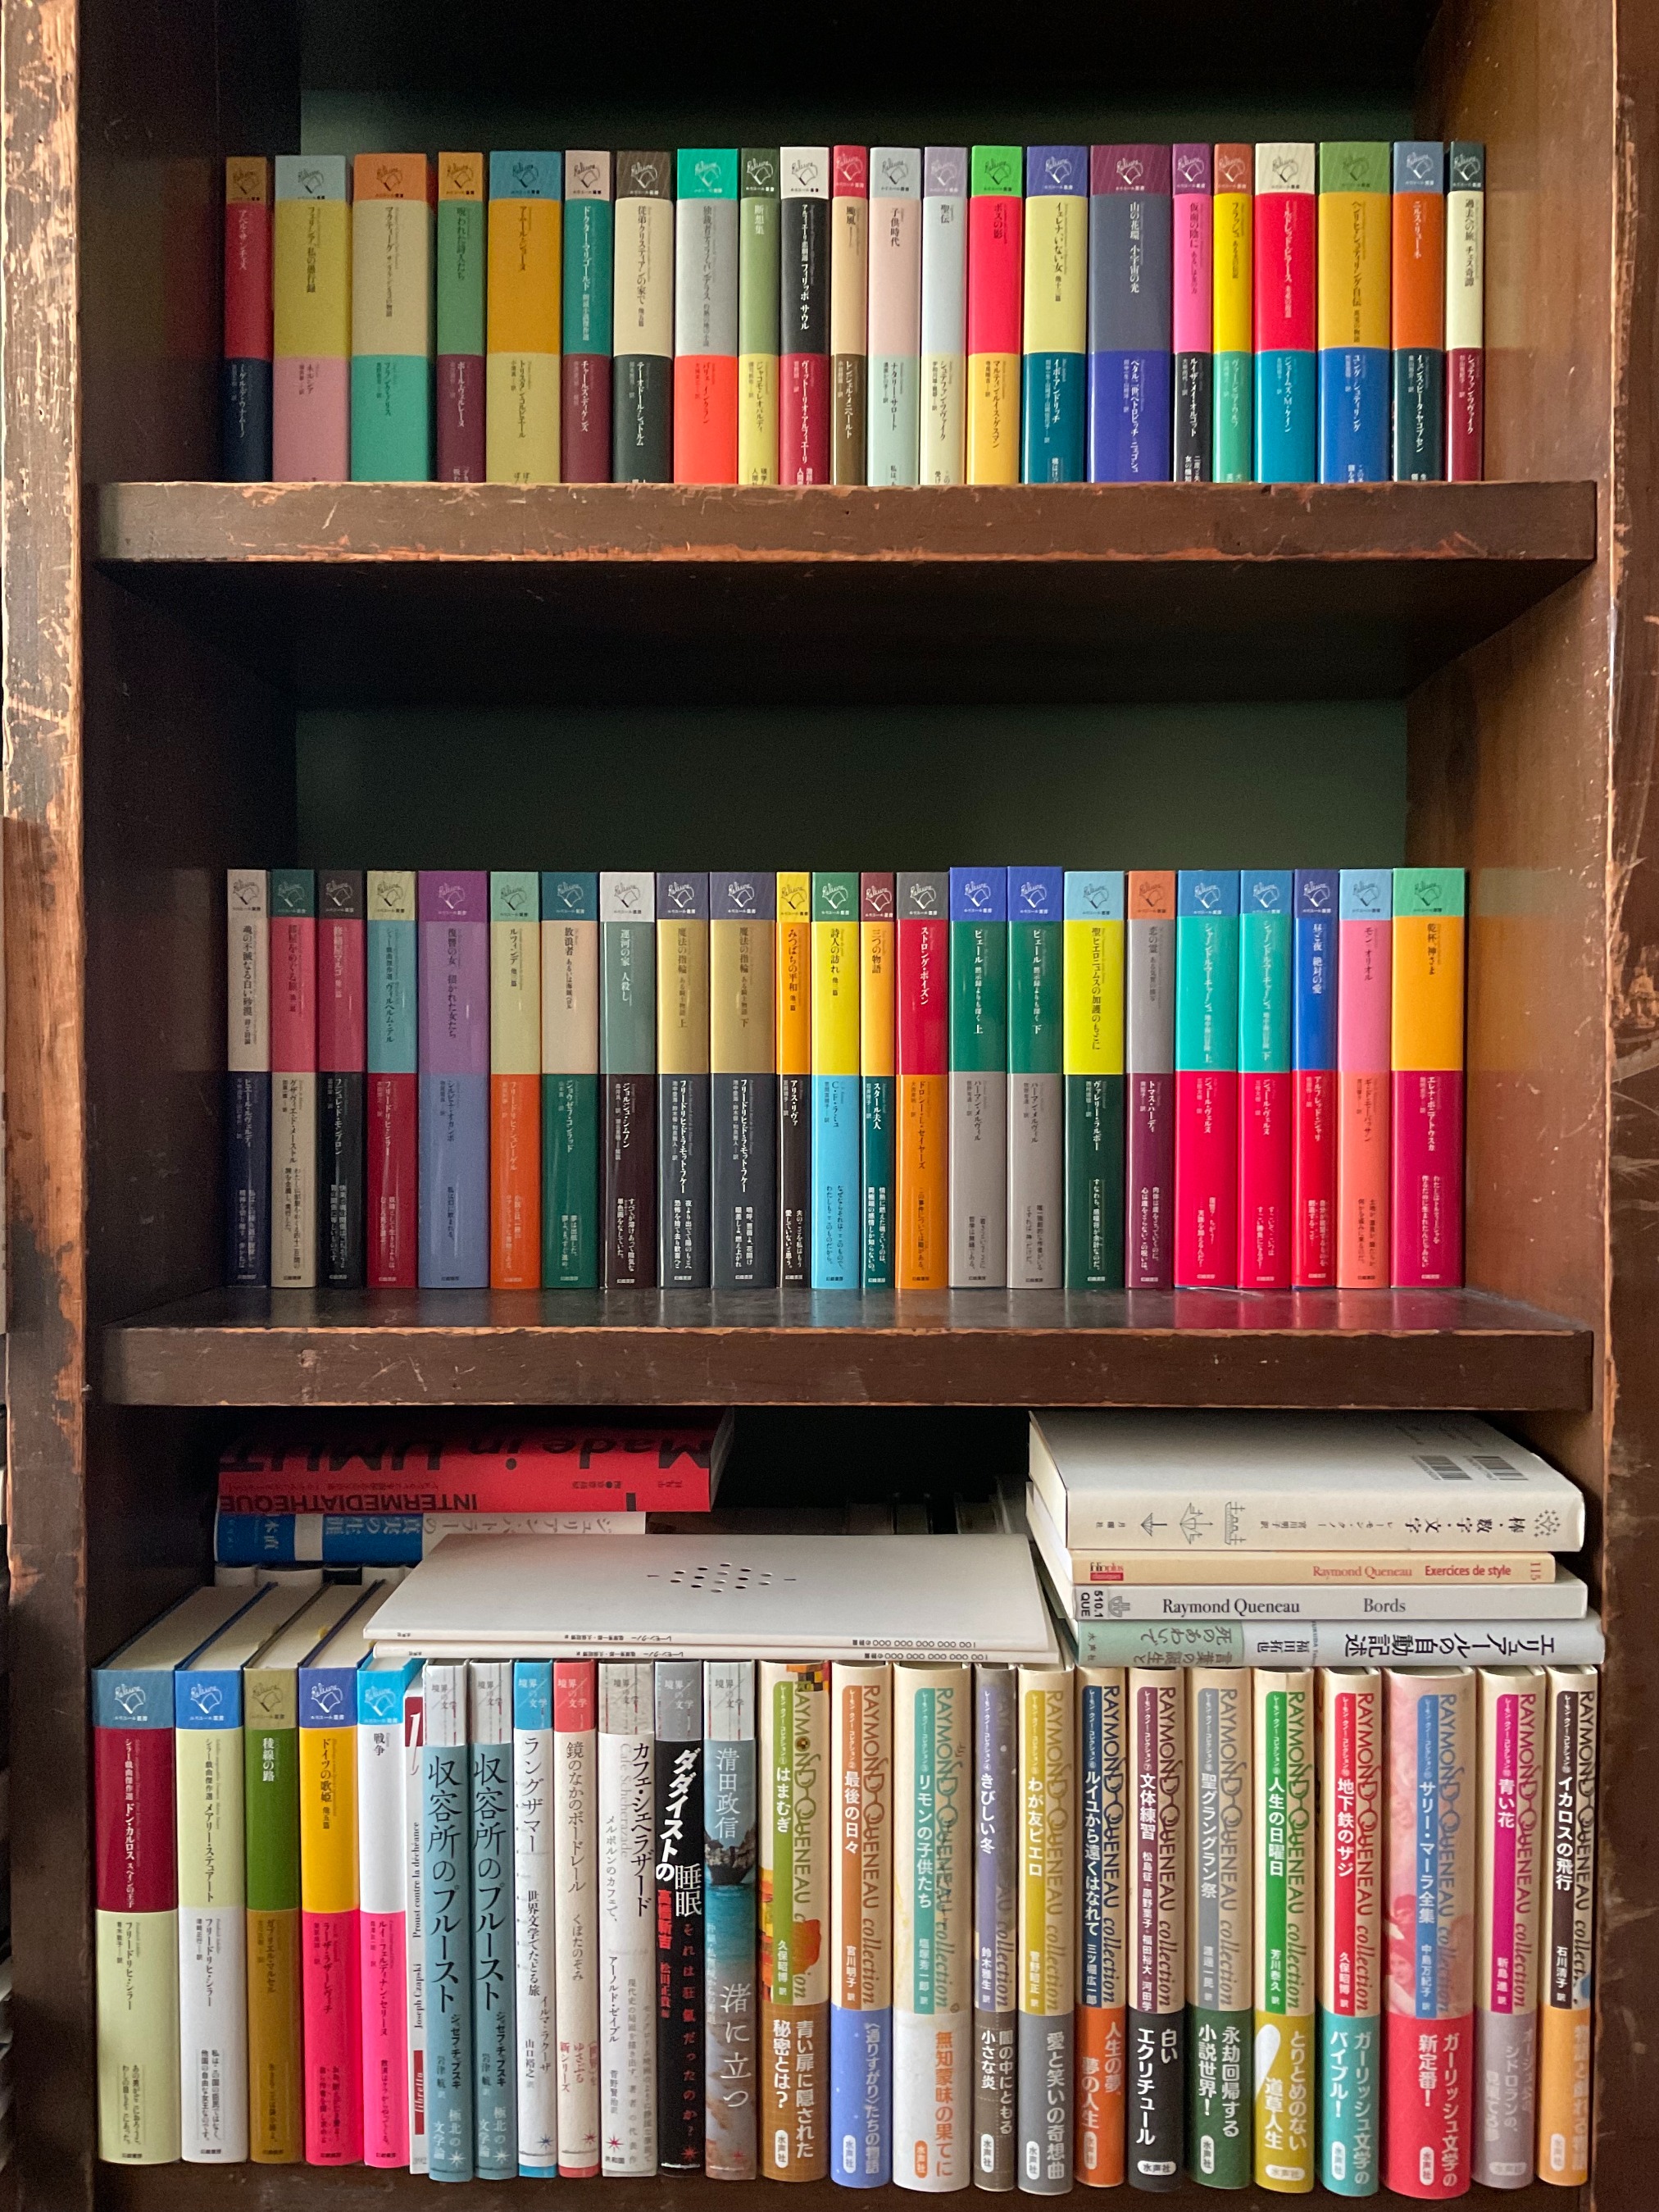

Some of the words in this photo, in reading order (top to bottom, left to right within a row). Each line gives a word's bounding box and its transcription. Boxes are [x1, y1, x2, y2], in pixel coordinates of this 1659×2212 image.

[754, 205, 764, 234] 断想集
[890, 207, 900, 247] 子供時代
[940, 204, 950, 224] 聖伝
[1129, 202, 1140, 239] 山の花環
[1464, 198, 1475, 242] 過去への旅
[800, 263, 809, 301] フィリッポ
[1129, 245, 1140, 293] 小宇宙の光
[800, 304, 809, 330] サウル
[564, 927, 574, 956] 放浪者
[620, 930, 630, 965] 運河の家
[677, 928, 687, 974] 魔法の指輪
[739, 927, 748, 974] 魔法の指輪
[788, 930, 798, 992] みつばちの平和
[830, 928, 839, 973] 詩人の訪れ
[871, 929, 880, 974] 三つの物語
[920, 926, 929, 1005] ストロング・ポイズン
[1312, 923, 1322, 952] 昼と夜
[448, 974, 457, 1039] 招かれた女たち
[621, 973, 630, 1002] 人殺し
[1092, 927, 1101, 1050] 聖ヒエロニュムスの加護のもとに
[1312, 957, 1322, 994] 絶対の愛
[679, 1018, 687, 1027] 上
[740, 1018, 748, 1027] 下
[974, 1024, 983, 1034] 上
[1033, 1025, 1041, 1033] 下
[873, 1083, 881, 1130] スタール夫人
[1093, 1081, 1101, 1151] ヴァレリー・ラルボー
[219, 1437, 443, 1473] UMUT
[468, 1436, 523, 1469] in
[543, 1434, 710, 1469] Made
[220, 1493, 477, 1511] INTERMEDIATHEQUE
[1405, 1518, 1525, 1533] 棒・数字・文字
[1080, 1593, 1089, 1617] QUE
[1094, 1591, 1103, 1618] 510.1
[1163, 1599, 1229, 1617] Raymond
[1234, 1599, 1300, 1614] Queneau
[1312, 1566, 1361, 1579] Raymond
[1365, 1566, 1412, 1579] Queneau
[1364, 1599, 1406, 1613] Bords
[1425, 1565, 1470, 1577] Exercices
[1472, 1565, 1485, 1576] de
[1488, 1566, 1511, 1578] style
[1530, 1563, 1541, 1581] 115
[1134, 1651, 1232, 1664] 言葉の誕生と
[1140, 1627, 1232, 1645] 死のあわいで
[1257, 1641, 1310, 1653] 福田拓也
[1345, 1632, 1554, 1658] エリュアールの自動記述
[320, 1738, 332, 1803] ドイツの歌姫
[373, 1733, 385, 1755] 戦争
[863, 1685, 889, 1792] RAYMOND
[1046, 1691, 1067, 1799] RAYMOND
[1103, 1685, 1125, 1793] RAYMOND
[1159, 1686, 1183, 1794] RAYMOND
[1220, 1689, 1246, 1796] RAYMOND
[1289, 1691, 1312, 1799] RAYMOND
[1357, 1693, 1380, 1800] RAYMOND
[1519, 1693, 1542, 1800] RAYMOND
[1579, 1691, 1595, 1798] RAYMOND
[523, 1737, 543, 1852] ラングザマー
[566, 1742, 585, 1892] 鏡のなかのボードレール
[656, 1748, 702, 1882] ダダイストの
[716, 1747, 740, 1838] 清田政信
[776, 1768, 791, 1833] はまむぎ
[844, 1772, 860, 1855] 最後の日々
[980, 1773, 996, 1854] きびしい冬
[1028, 1777, 1043, 1877] わが友ピエロ
[1139, 1774, 1157, 1840] 文体練習
[1269, 1777, 1284, 1877] 人生の日曜日
[1337, 1778, 1354, 1877] 地下鉄のザジ
[1498, 1778, 1516, 1828] 青い花
[125, 1803, 134, 1860] ドン・カルロス
[411, 1823, 420, 1868] déchéance
[630, 1743, 652, 1917] カフェ・シェヘラザード
[863, 1803, 885, 1909] QUENEAU
[916, 1774, 934, 1908] リモンの子供たち
[1046, 1809, 1068, 1915] QUENEAU
[1084, 1772, 1102, 1936] ルイユから遠くはなれて
[1103, 1802, 1124, 1908] QUENEAU
[1159, 1805, 1180, 1911] QUENEAU
[1201, 1773, 1217, 1898] 聖グラングラン祭
[1220, 1806, 1243, 1911] QUENEAU
[1288, 1809, 1310, 1914] QUENEAU
[1357, 1811, 1379, 1916] QUENEAU
[1419, 1782, 1436, 1923] サリー・マーラ全集
[1517, 1810, 1538, 1914] QUENEAU
[1556, 1777, 1575, 1891] イカロスの飛行
[1575, 1808, 1594, 1911] QUENEAU
[412, 1870, 420, 1880] la
[428, 1755, 463, 2014] 収容所のプルースト
[473, 1753, 507, 2011] 収容所のプルースト
[675, 1864, 702, 1916] 睡眠
[413, 1909, 421, 1938] Proust
[527, 1891, 540, 1996] 世界文学でたどる旅
[571, 1914, 584, 1981] くぼたのぞみ
[413, 1963, 424, 1997] Czapski
[862, 1918, 882, 2004] collection
[1288, 1923, 1307, 2009] collection
[1357, 1925, 1375, 2011] collection
[1514, 1923, 1533, 2008] collection
[413, 1998, 424, 2029] Joseph
[540, 1996, 552, 2075] イルマ・ラクーザ
[609, 1956, 620, 2042] アーノルド・ゼイブル
[720, 1983, 752, 2107] 渚に立つ
[773, 2019, 792, 2109] 秘密とは？
[980, 2030, 997, 2091] 小さな炎
[1161, 2029, 1178, 2064] 白い
[1198, 2024, 1217, 2116] 小説世界！
[1329, 2032, 1348, 2119] バイブル！
[1418, 2034, 1438, 2107] 新定番！
[796, 2020, 814, 2159] 青い扉に隠された
[1047, 2032, 1066, 2180] 愛と笑いの奇想曲
[1081, 2056, 1100, 2129] 夢の人生
[1136, 2028, 1156, 2146] エクリチュール
[1221, 2026, 1241, 2138] 永劫回帰する
[1264, 2078, 1284, 2151] 道草人生
[1289, 2032, 1307, 2151] とりとめのない
[1353, 2032, 1372, 2185] ガーリッシュ文学の
[1442, 2032, 1461, 2187] ガーリッシュ文学の
